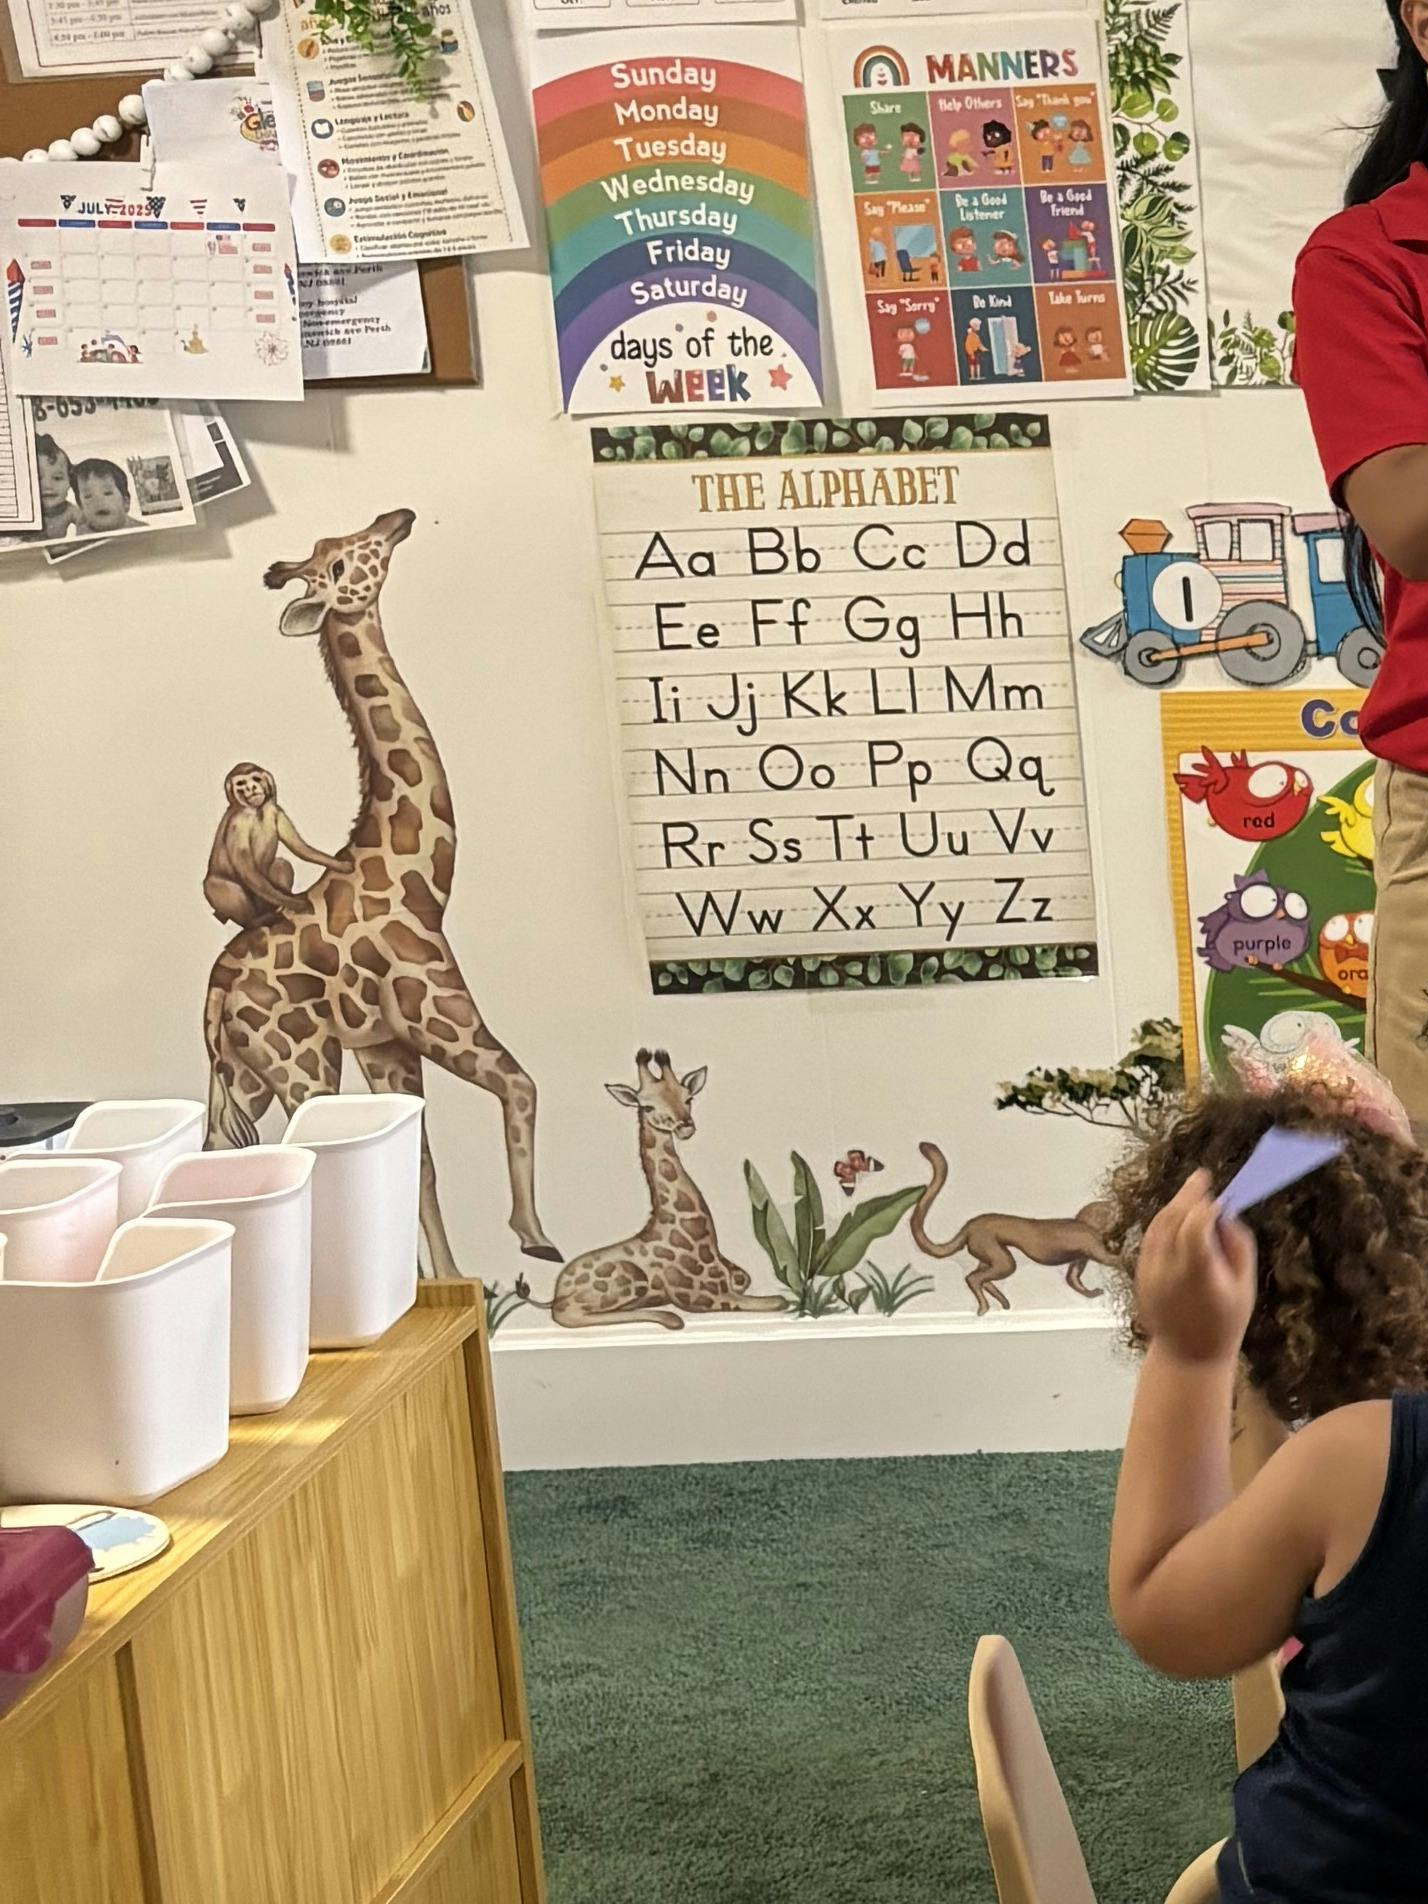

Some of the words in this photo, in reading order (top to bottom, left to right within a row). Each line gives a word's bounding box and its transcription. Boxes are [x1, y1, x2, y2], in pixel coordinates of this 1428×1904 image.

[610, 59, 716, 92] Sunday
[926, 49, 1078, 83] MANNERS
[614, 96, 719, 127] Monday
[870, 100, 901, 114] Share
[939, 98, 962, 111] Help
[965, 97, 1001, 110] Others
[1016, 95, 1033, 108] Say
[614, 133, 727, 163] Tuesday
[601, 170, 754, 205] Wednesday
[955, 194, 969, 207] Be
[972, 197, 978, 205] a
[980, 193, 1007, 206] Good
[1040, 190, 1055, 203] Be
[1058, 193, 1064, 202] a
[1066, 189, 1092, 201] Good
[78, 202, 111, 215] JULY
[614, 204, 738, 236] Thursday
[864, 201, 884, 216] Say
[960, 208, 1005, 221] Listener
[1051, 204, 1084, 217] Friend
[646, 238, 730, 270] Friday
[630, 275, 747, 308] Saturday
[973, 296, 986, 309] Be
[989, 295, 1011, 308] Kind
[1049, 291, 1072, 304] Take
[1076, 291, 1105, 304] Turns
[877, 300, 897, 314] Say
[611, 330, 673, 367] days
[687, 328, 715, 357] of
[727, 326, 773, 357] the
[692, 472, 765, 512] THE
[778, 466, 959, 510] ALPHABET
[635, 532, 715, 579] Aa
[747, 526, 821, 575] Bb
[853, 523, 926, 570] Cc
[956, 519, 1030, 568] Dd
[655, 602, 719, 650] Ee
[751, 598, 811, 646] Ff
[844, 595, 920, 658] Gg
[951, 591, 1024, 639] Hh
[649, 676, 681, 723] Ii
[707, 673, 757, 736] Jj
[782, 670, 847, 718] Kk
[872, 667, 917, 715] Ll
[946, 665, 1044, 711] Mm
[1301, 699, 1360, 738] Co
[655, 749, 729, 795] Nn
[759, 744, 835, 790] Oo
[868, 740, 932, 801] Pp
[967, 736, 1055, 796] Qq
[1243, 812, 1274, 829] red
[662, 822, 725, 868] Rr
[748, 818, 801, 864] Ss
[816, 815, 874, 861] Tt
[901, 811, 968, 857] Uu
[989, 808, 1054, 853] Vv
[675, 889, 783, 936] Ww
[812, 886, 876, 932] Xx
[899, 881, 964, 941] Yy
[995, 878, 1053, 923] Zz
[1233, 935, 1291, 961] purple
[1338, 966, 1368, 981] ora
